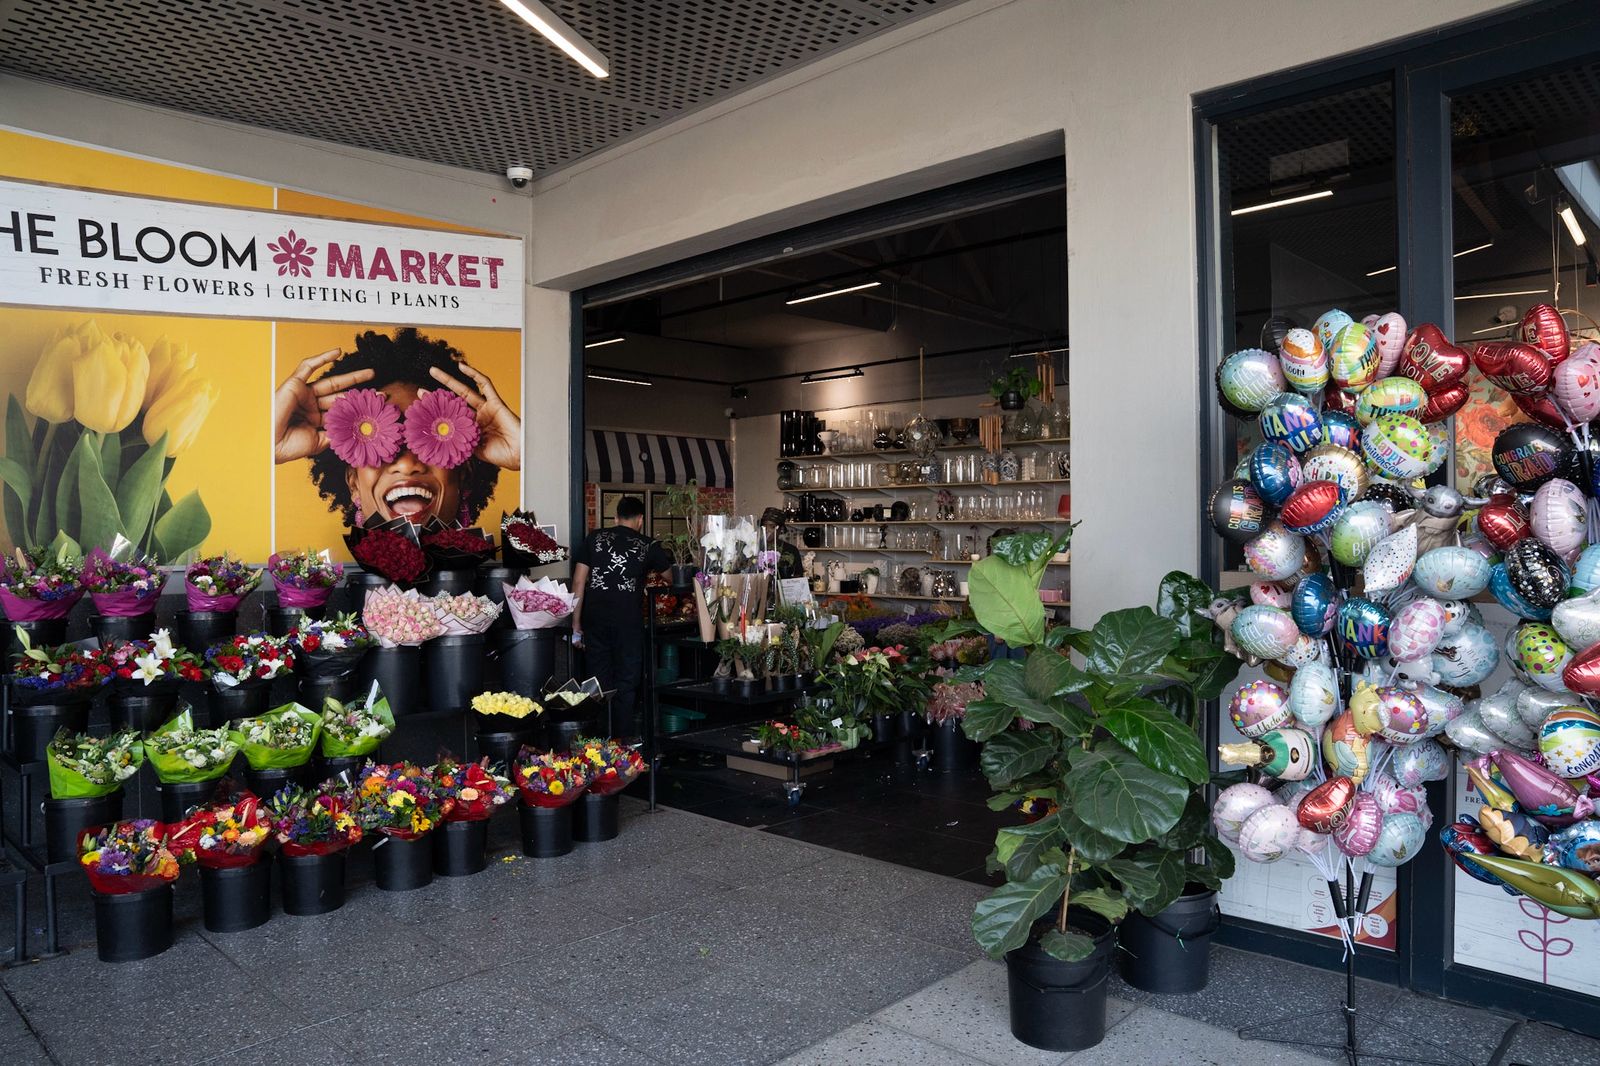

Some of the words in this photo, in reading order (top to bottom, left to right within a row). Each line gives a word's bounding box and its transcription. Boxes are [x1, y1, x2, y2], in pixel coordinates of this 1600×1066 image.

[78, 218, 258, 272] BLOOM
[326, 242, 504, 290] MARKET
[40, 266, 130, 289] FRESH
[142, 274, 255, 297] FLOWERS
[282, 284, 367, 304] GIFTING
[391, 292, 460, 309] PLANTS
[1362, 434, 1412, 478] Anniversary!
[1372, 433, 1406, 466] Happy
[1494, 443, 1544, 465] CONGRATS
[1500, 452, 1555, 483] GRAD
